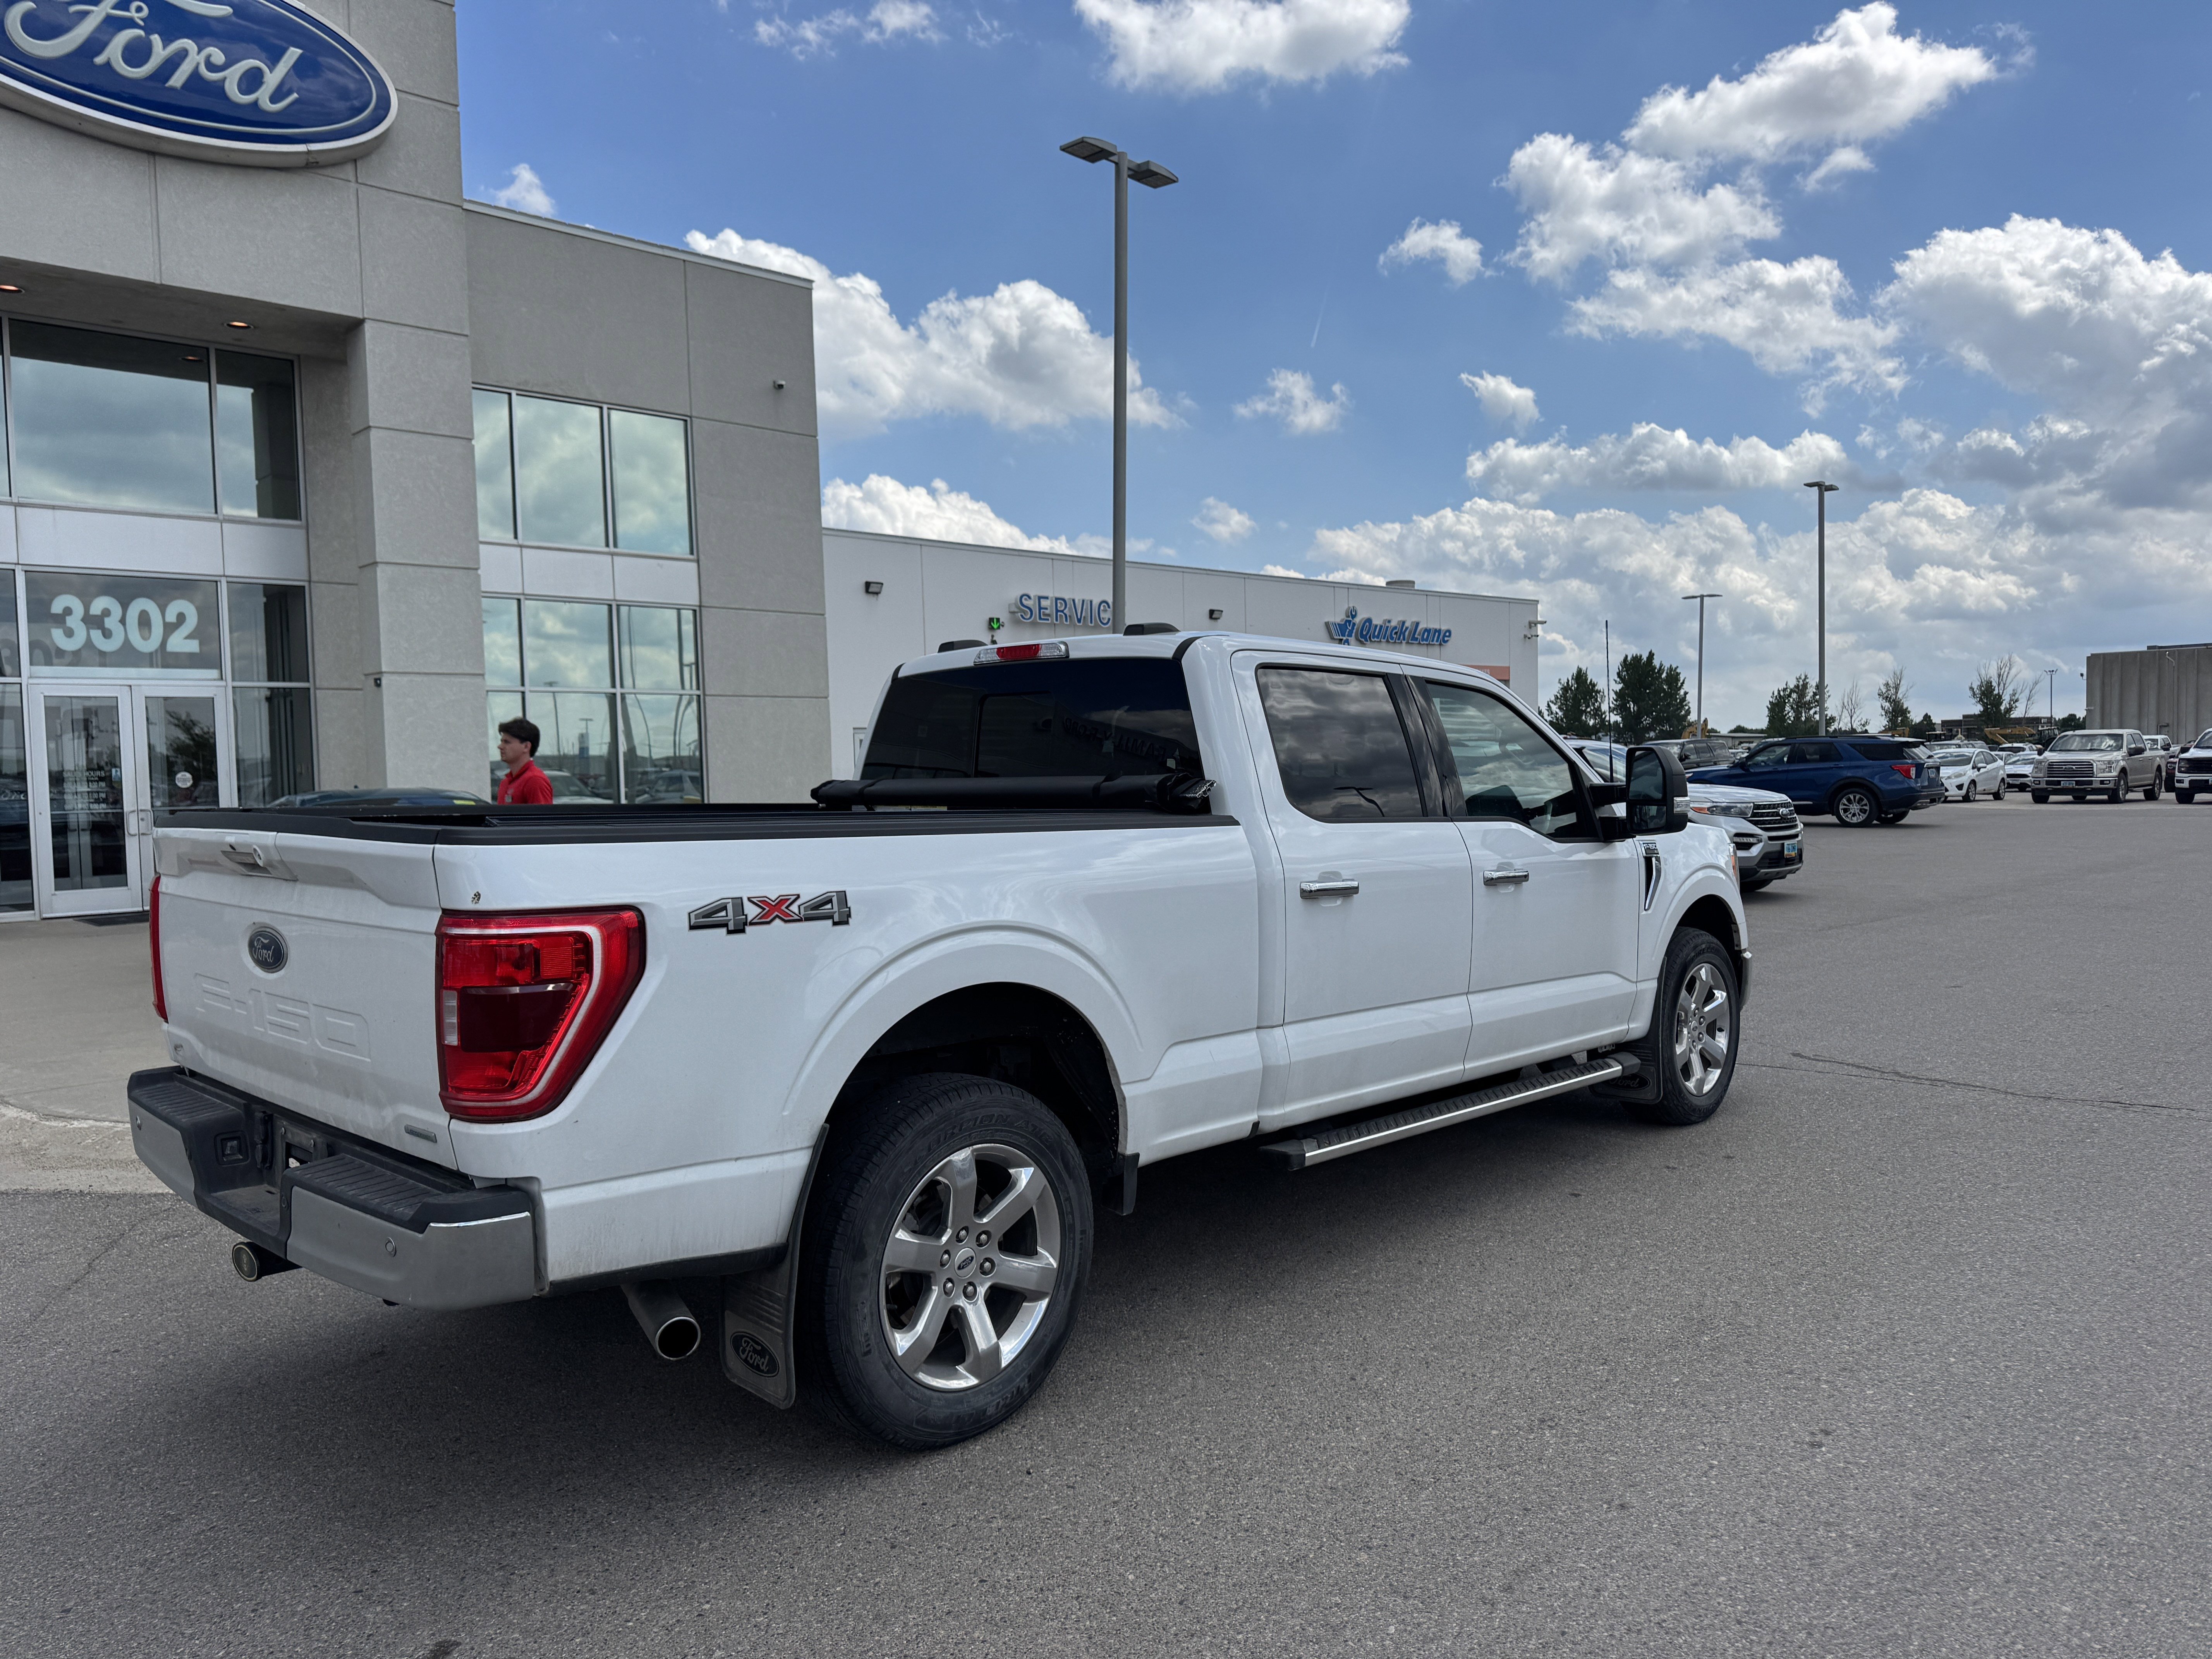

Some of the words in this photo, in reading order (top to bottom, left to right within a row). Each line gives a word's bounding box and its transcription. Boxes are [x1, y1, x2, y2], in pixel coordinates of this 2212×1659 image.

[4, 0, 304, 113] Ford
[50, 594, 200, 653] 3302
[1017, 592, 1113, 627] SERVIC
[252, 936, 274, 962] Ford
[194, 972, 371, 1063] F-150
[739, 1337, 769, 1372] Ford
